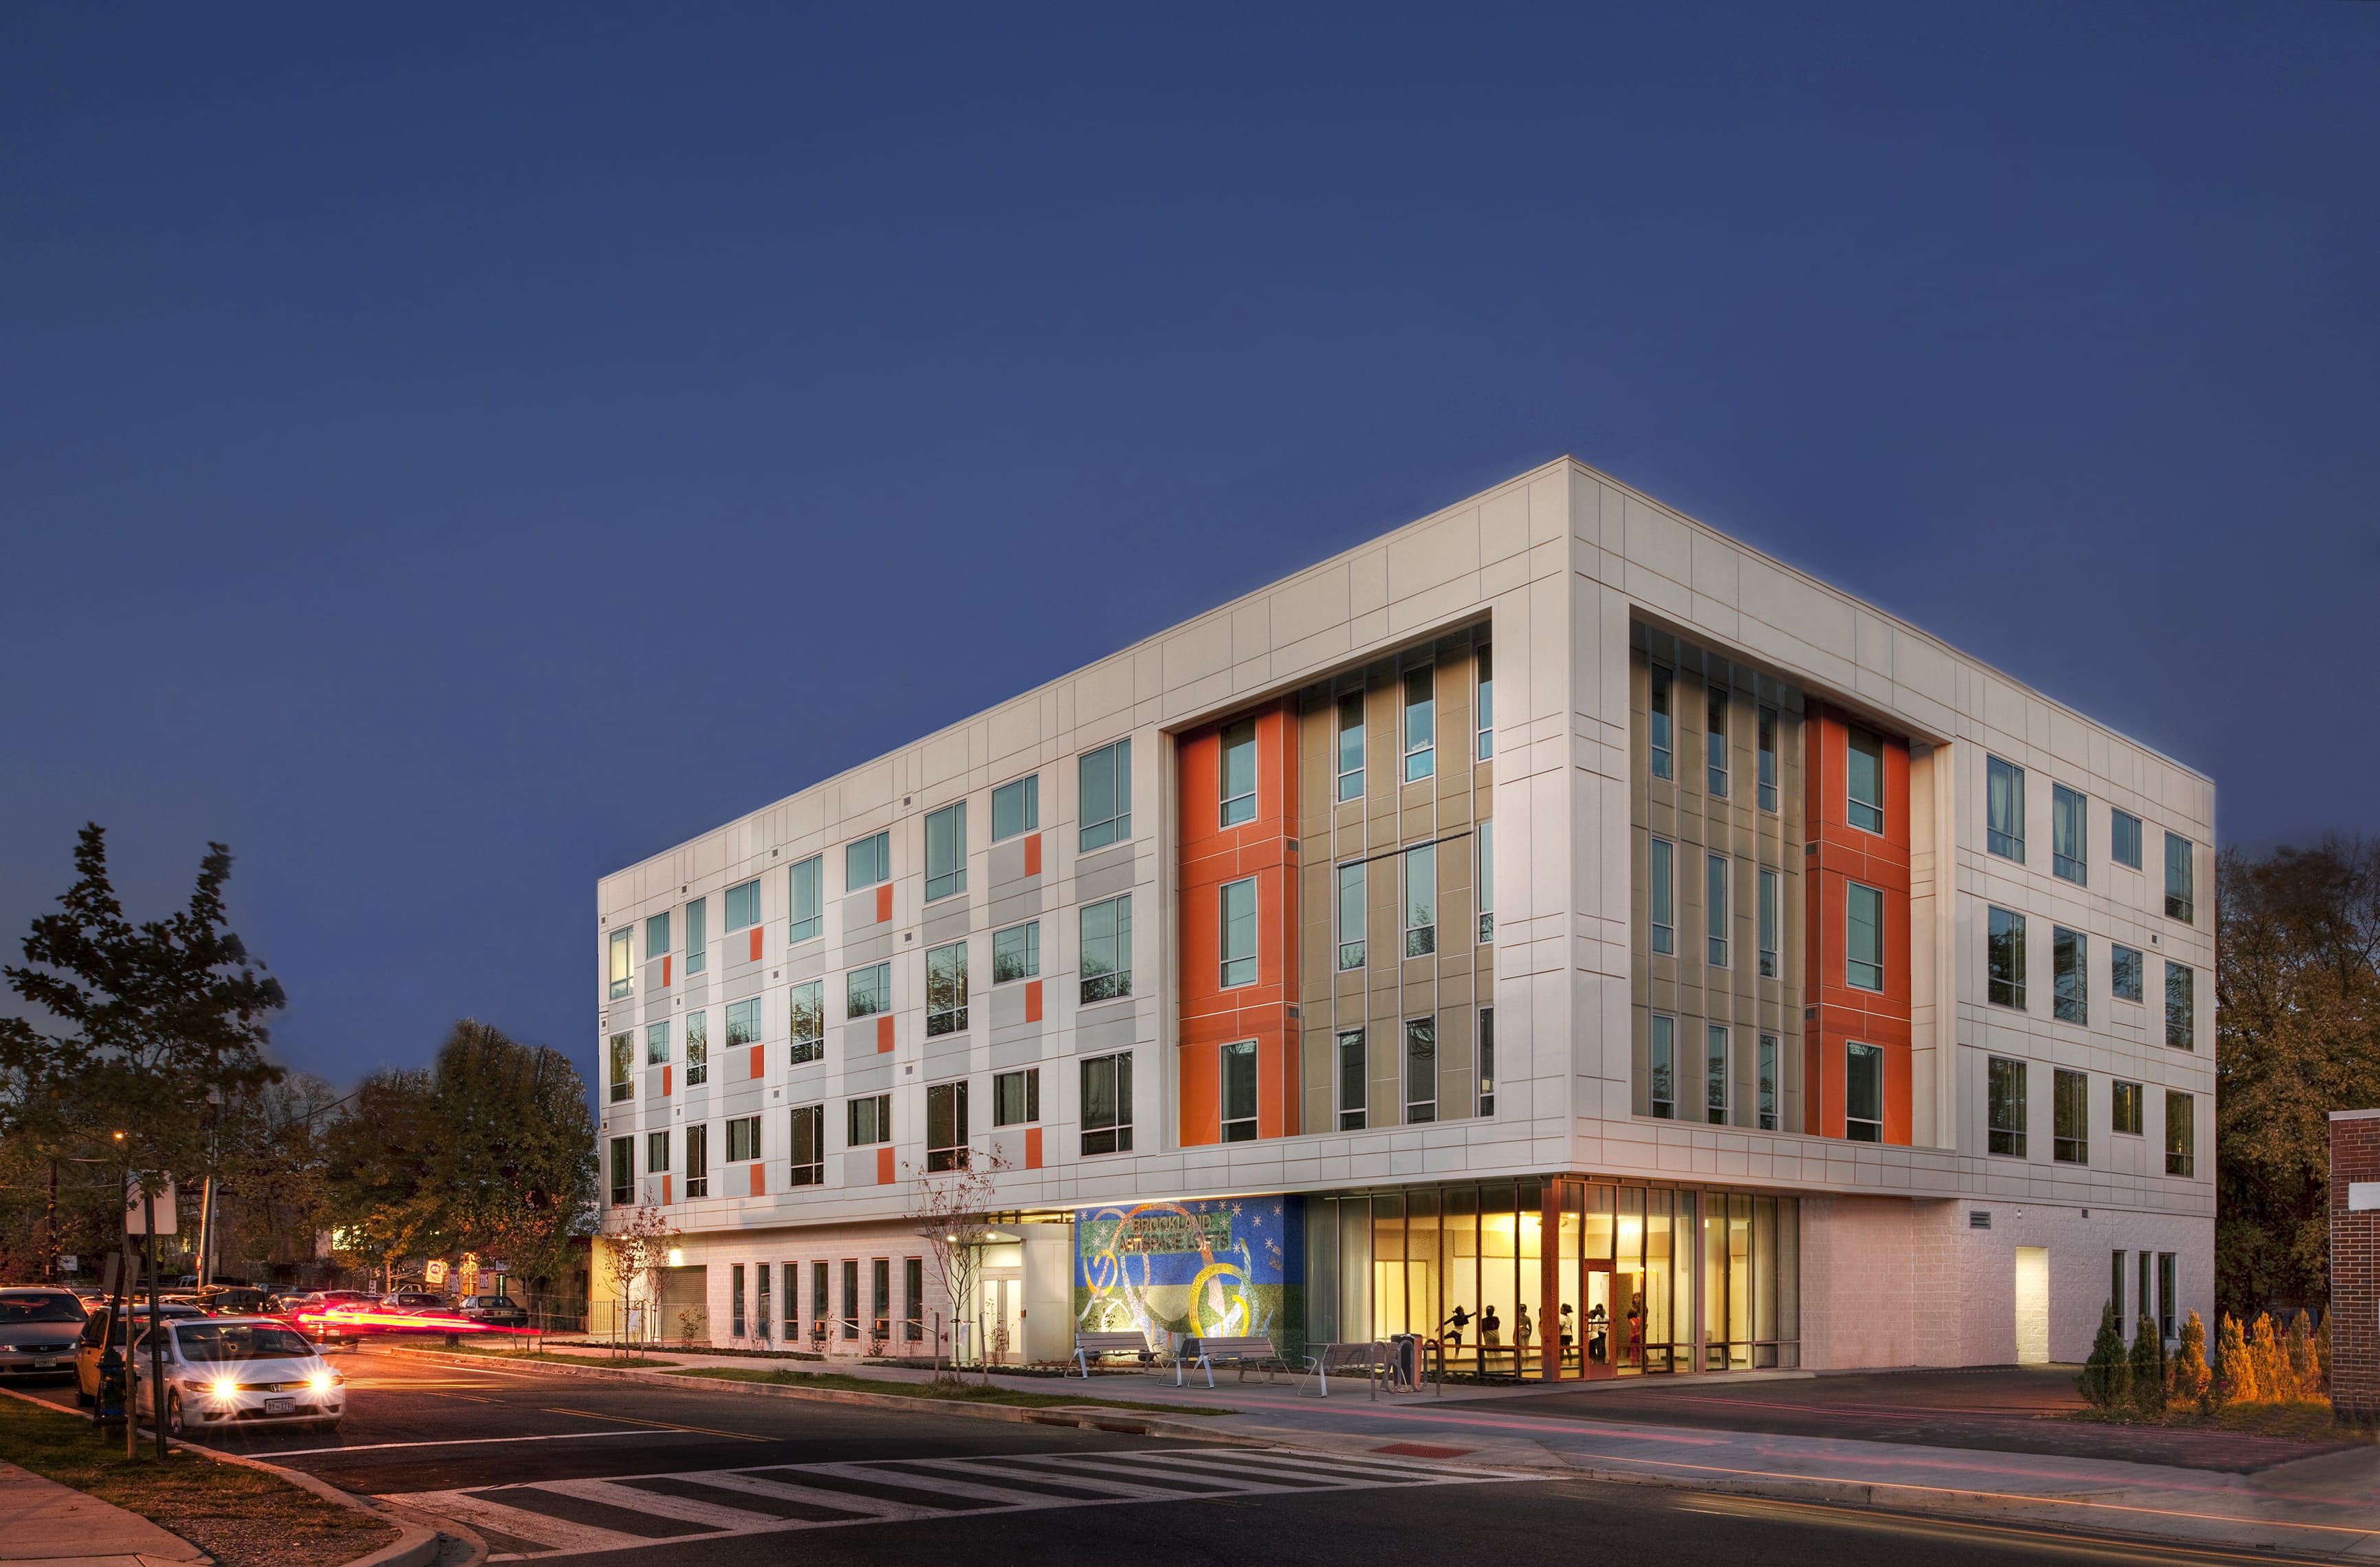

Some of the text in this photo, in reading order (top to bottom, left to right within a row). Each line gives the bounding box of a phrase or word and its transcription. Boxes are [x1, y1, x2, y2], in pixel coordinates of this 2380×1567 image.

[1133, 1215, 1212, 1232] BROOKLAND
[1118, 1234, 1229, 1253] ARTSPACE LOFTS
